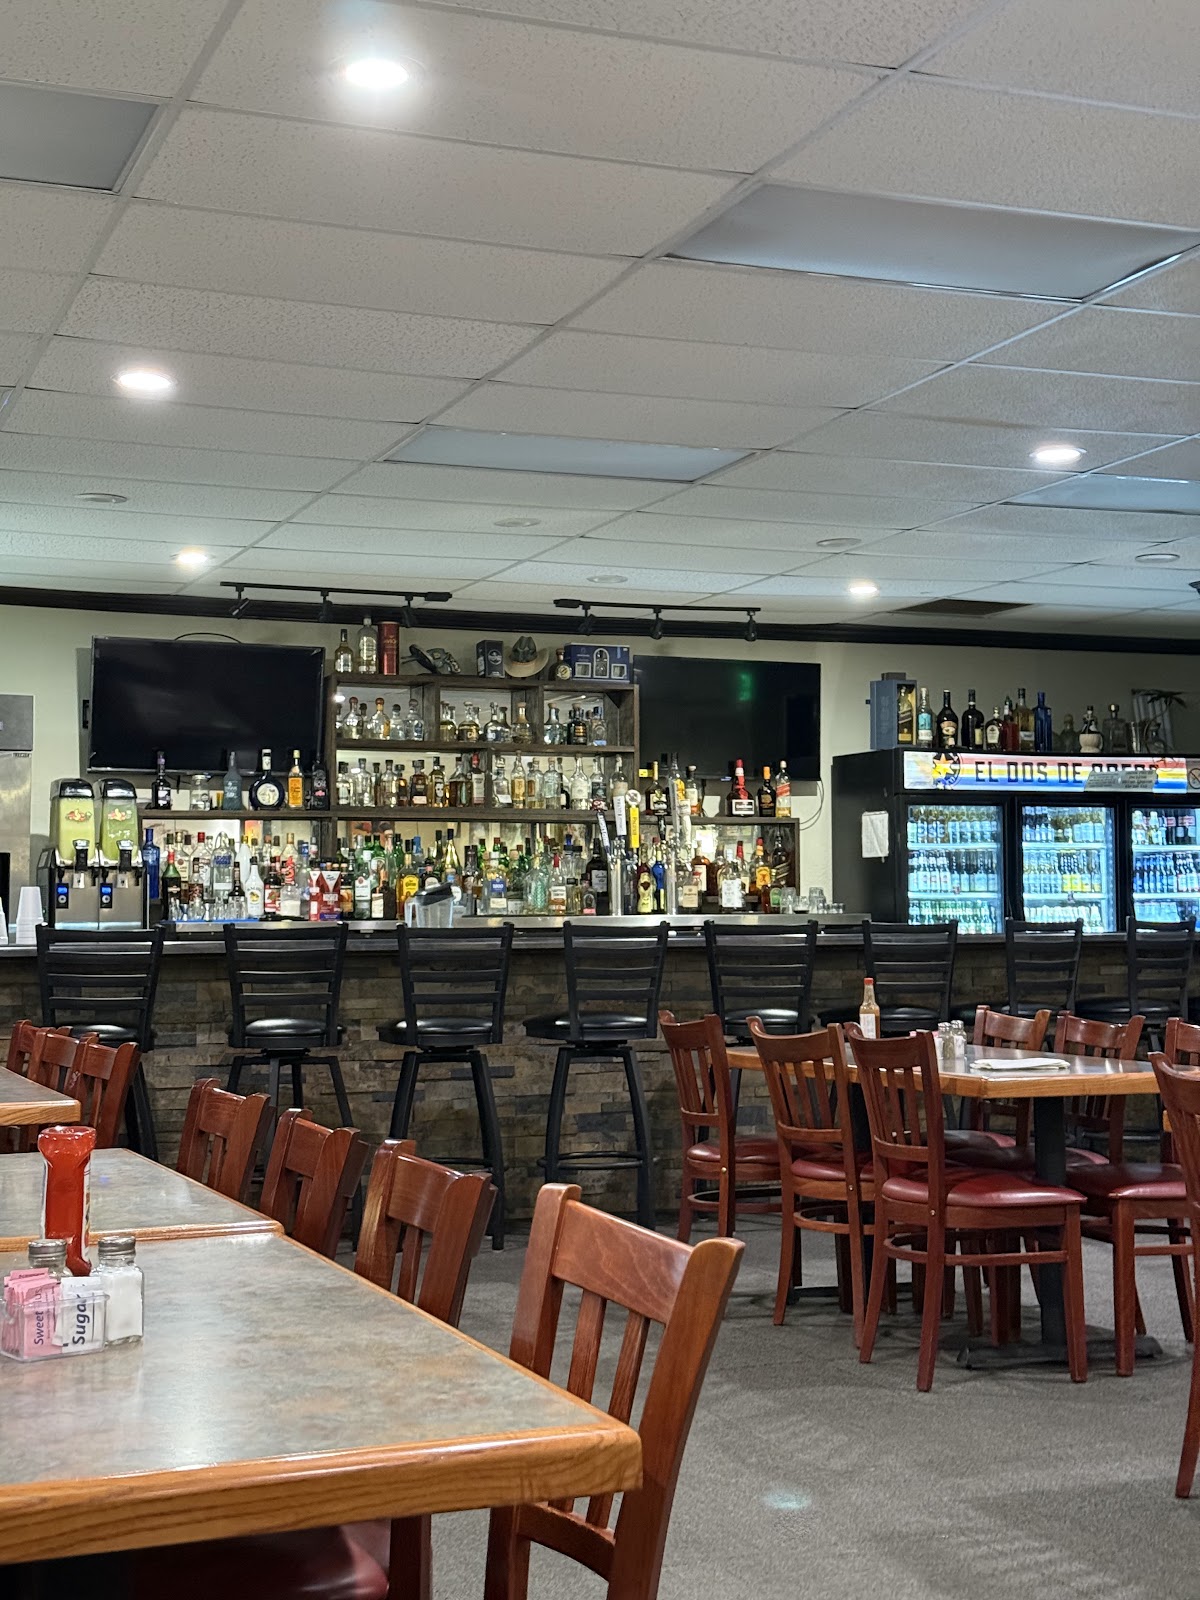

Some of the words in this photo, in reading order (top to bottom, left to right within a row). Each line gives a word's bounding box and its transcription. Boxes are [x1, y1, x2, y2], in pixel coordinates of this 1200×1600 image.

[975, 761, 999, 782] EL
[1006, 762, 1048, 783] DOS
[1058, 762, 1083, 783] DE
[34, 1310, 44, 1345] Sweet
[72, 1293, 90, 1345] Sugar
